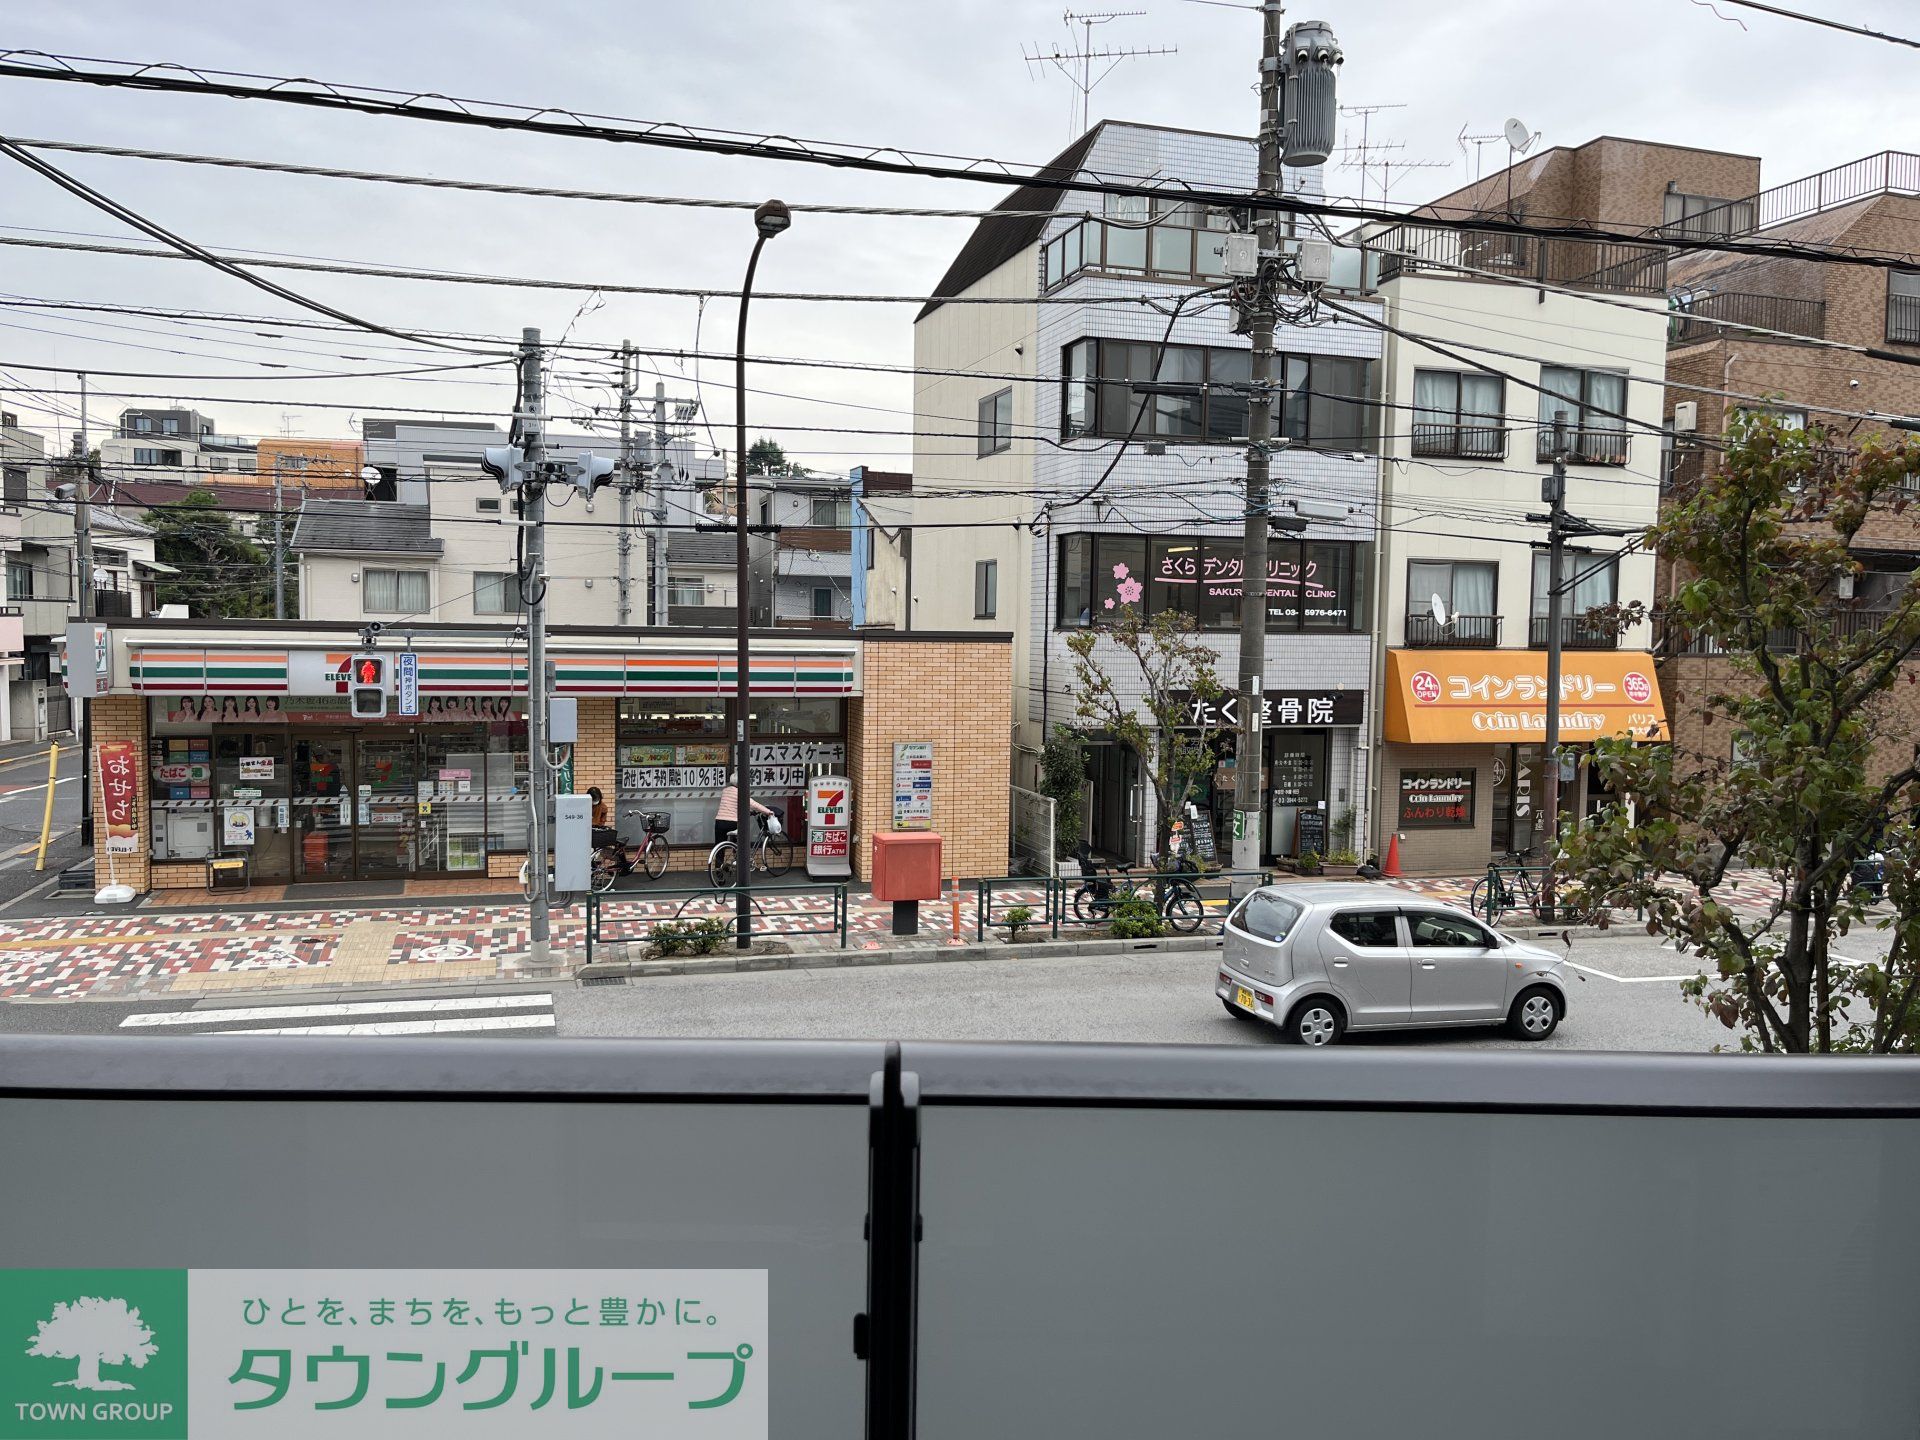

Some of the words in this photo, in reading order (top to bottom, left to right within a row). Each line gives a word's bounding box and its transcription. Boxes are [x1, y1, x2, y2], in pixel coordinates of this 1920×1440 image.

[1209, 588, 1244, 597] SAKUR
[1264, 590, 1298, 598] ENTAL
[1305, 590, 1337, 598] CLINIC
[1269, 609, 1284, 618] TEL
[325, 673, 353, 681] ELEVE
[1448, 674, 1616, 700] コインランドリー
[1472, 712, 1517, 731] Coin
[1628, 713, 1656, 724] パリス
[160, 767, 186, 778] たばこ
[1402, 777, 1472, 790] コインランドリー
[1516, 748, 1531, 817] PARIS
[1409, 794, 1428, 803] Coin
[813, 831, 824, 843] 酒
[824, 831, 847, 842] たばこ
